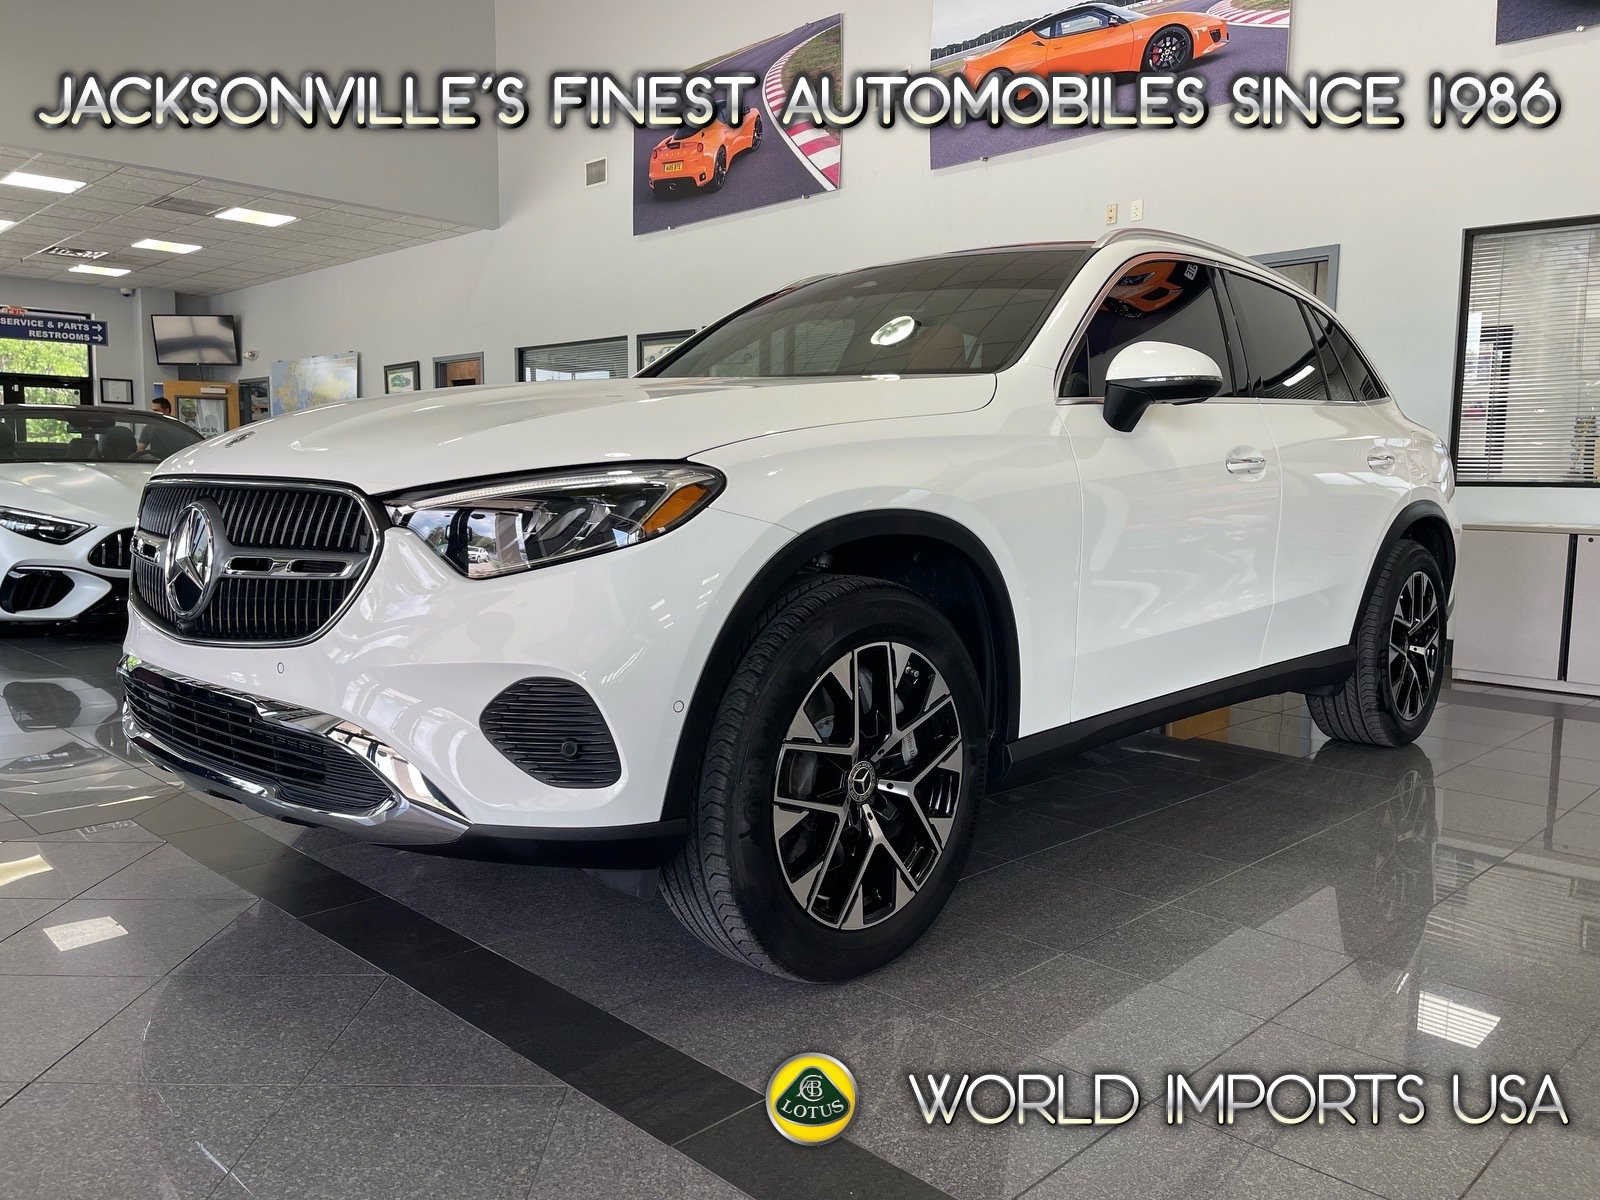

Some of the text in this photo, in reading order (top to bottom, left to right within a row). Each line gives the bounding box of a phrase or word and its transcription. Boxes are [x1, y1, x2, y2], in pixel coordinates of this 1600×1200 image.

[0, 317, 44, 328] SERVICE
[57, 321, 90, 331] PARTS
[29, 330, 90, 340] RESTROOMS
